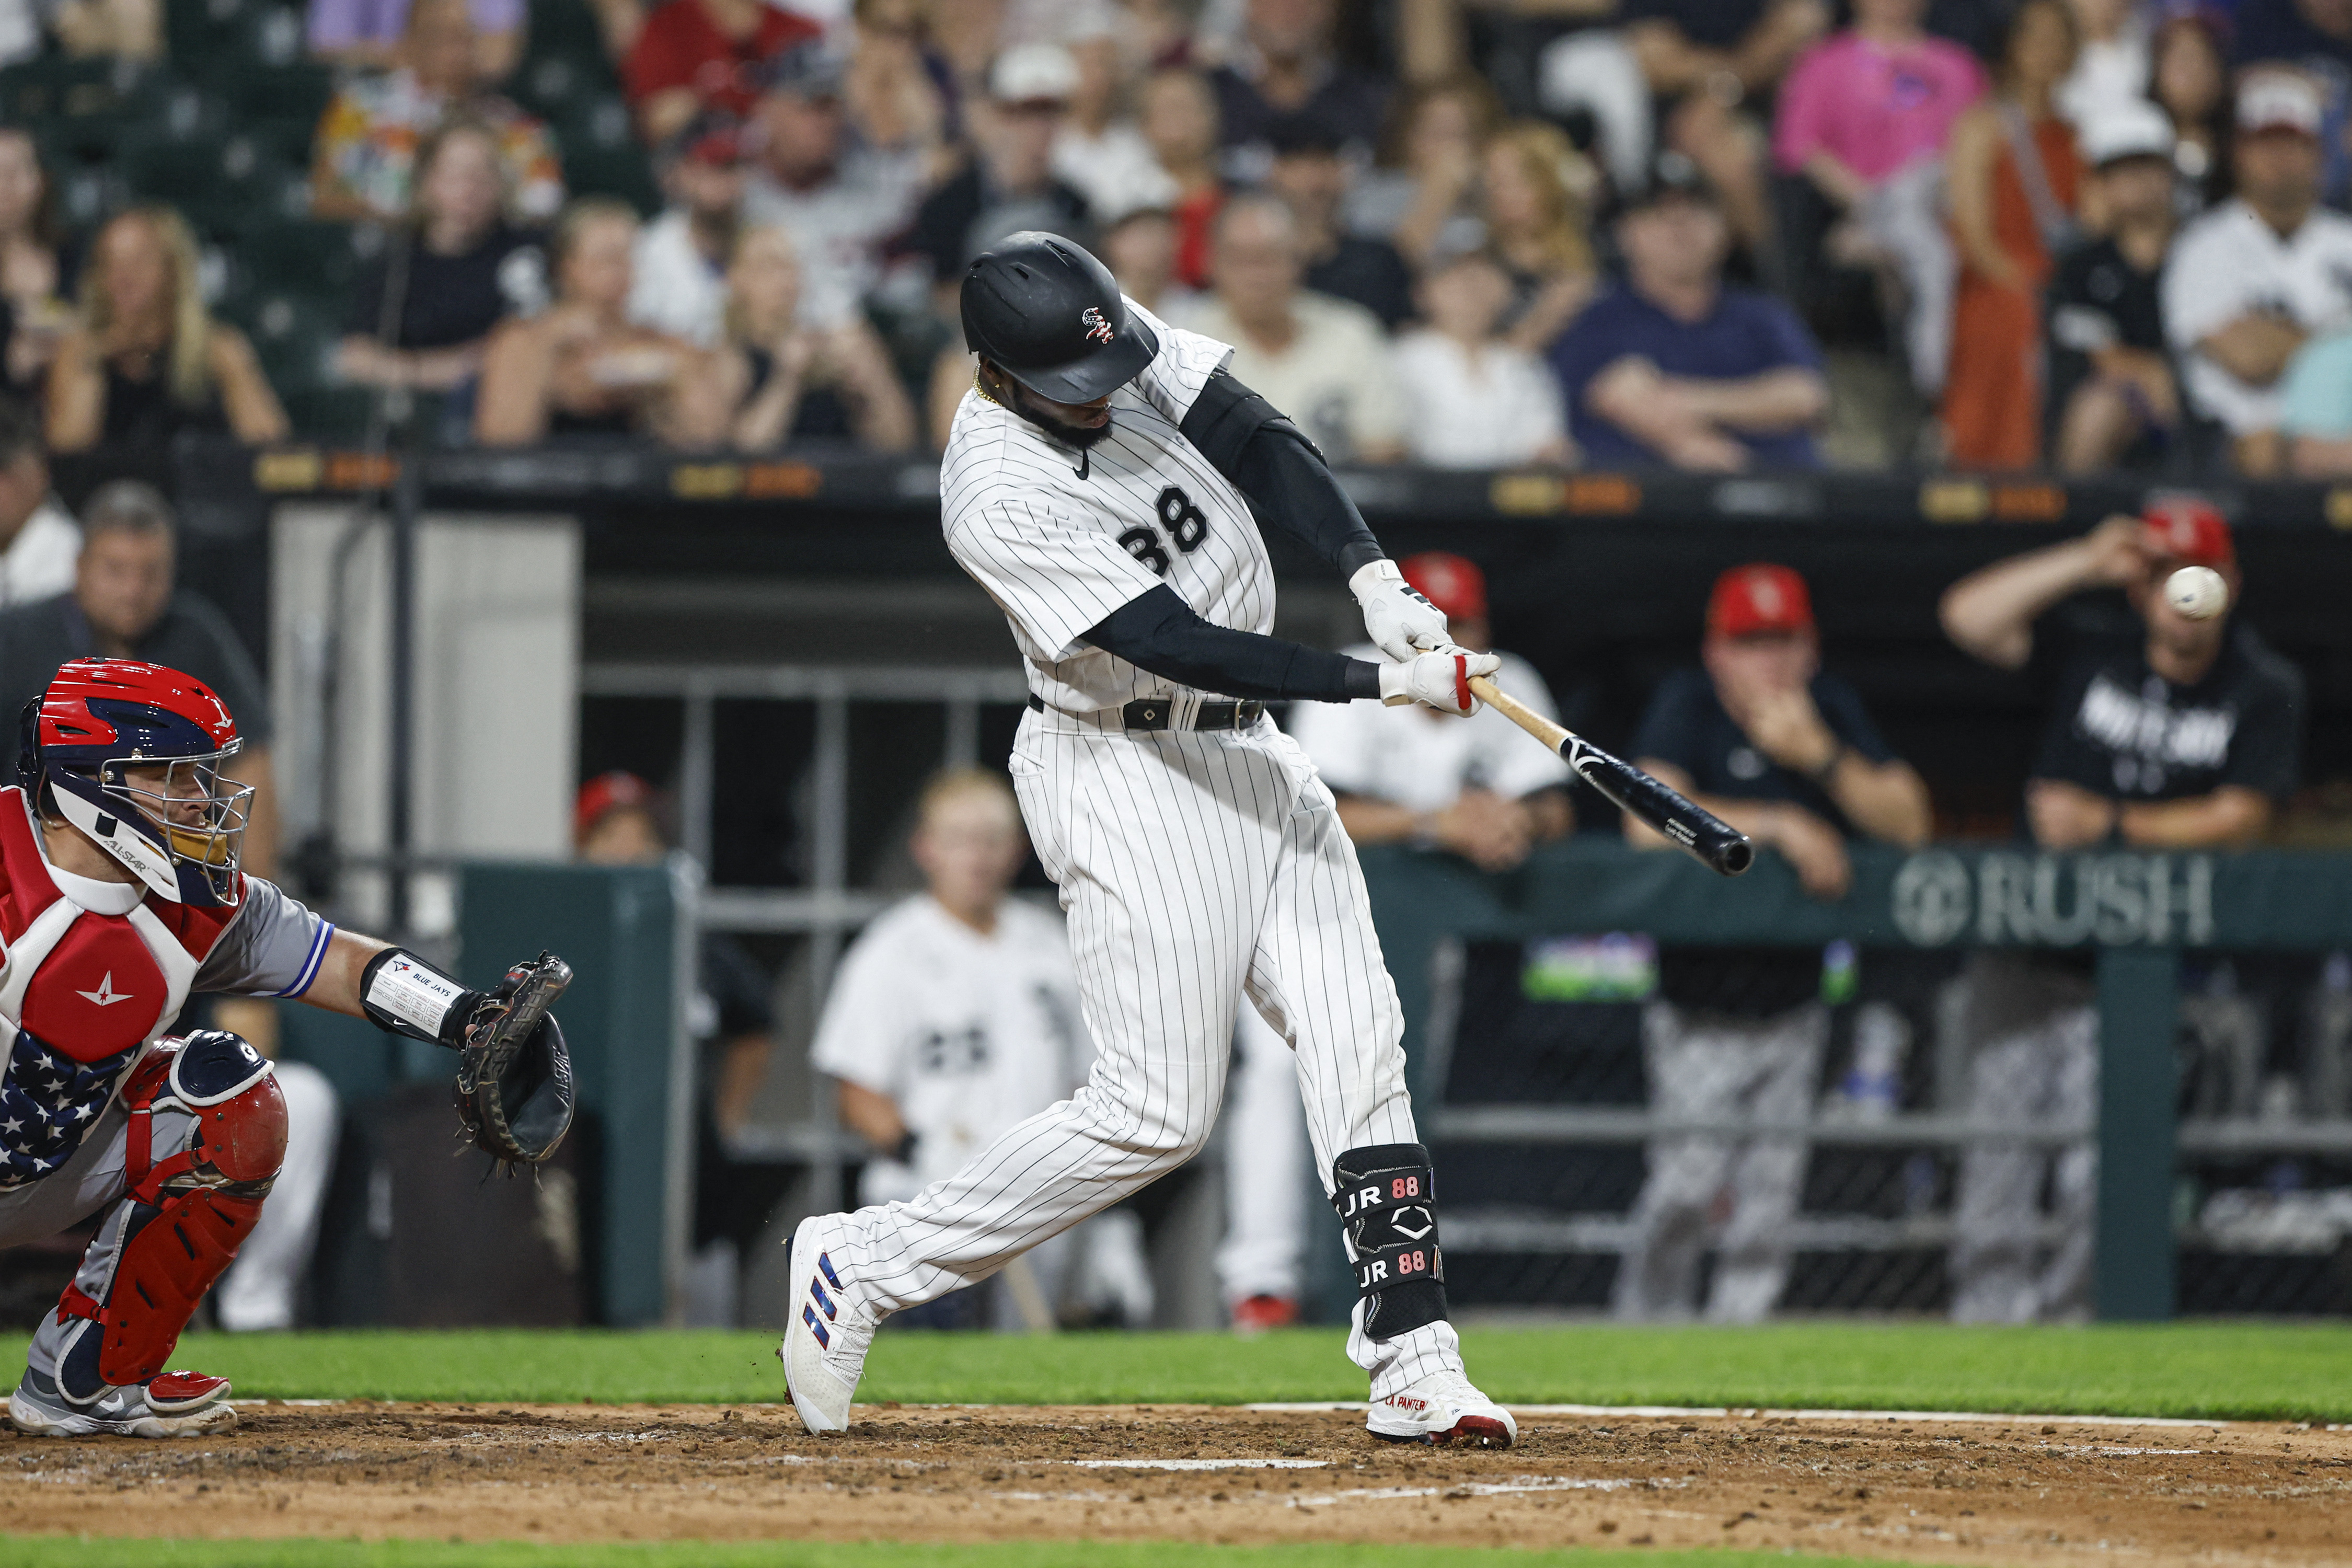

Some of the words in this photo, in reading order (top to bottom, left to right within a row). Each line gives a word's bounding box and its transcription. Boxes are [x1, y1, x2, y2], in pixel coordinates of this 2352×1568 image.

[103, 840, 146, 872] ALL-STAR
[1978, 852, 2213, 946] RUSH
[413, 973, 431, 985] BLUE
[431, 984, 451, 997] JAYS
[1344, 1186, 1383, 1217] JR
[1392, 1176, 1419, 1199] 88
[1360, 1260, 1389, 1288] JR
[1398, 1250, 1425, 1274] 88
